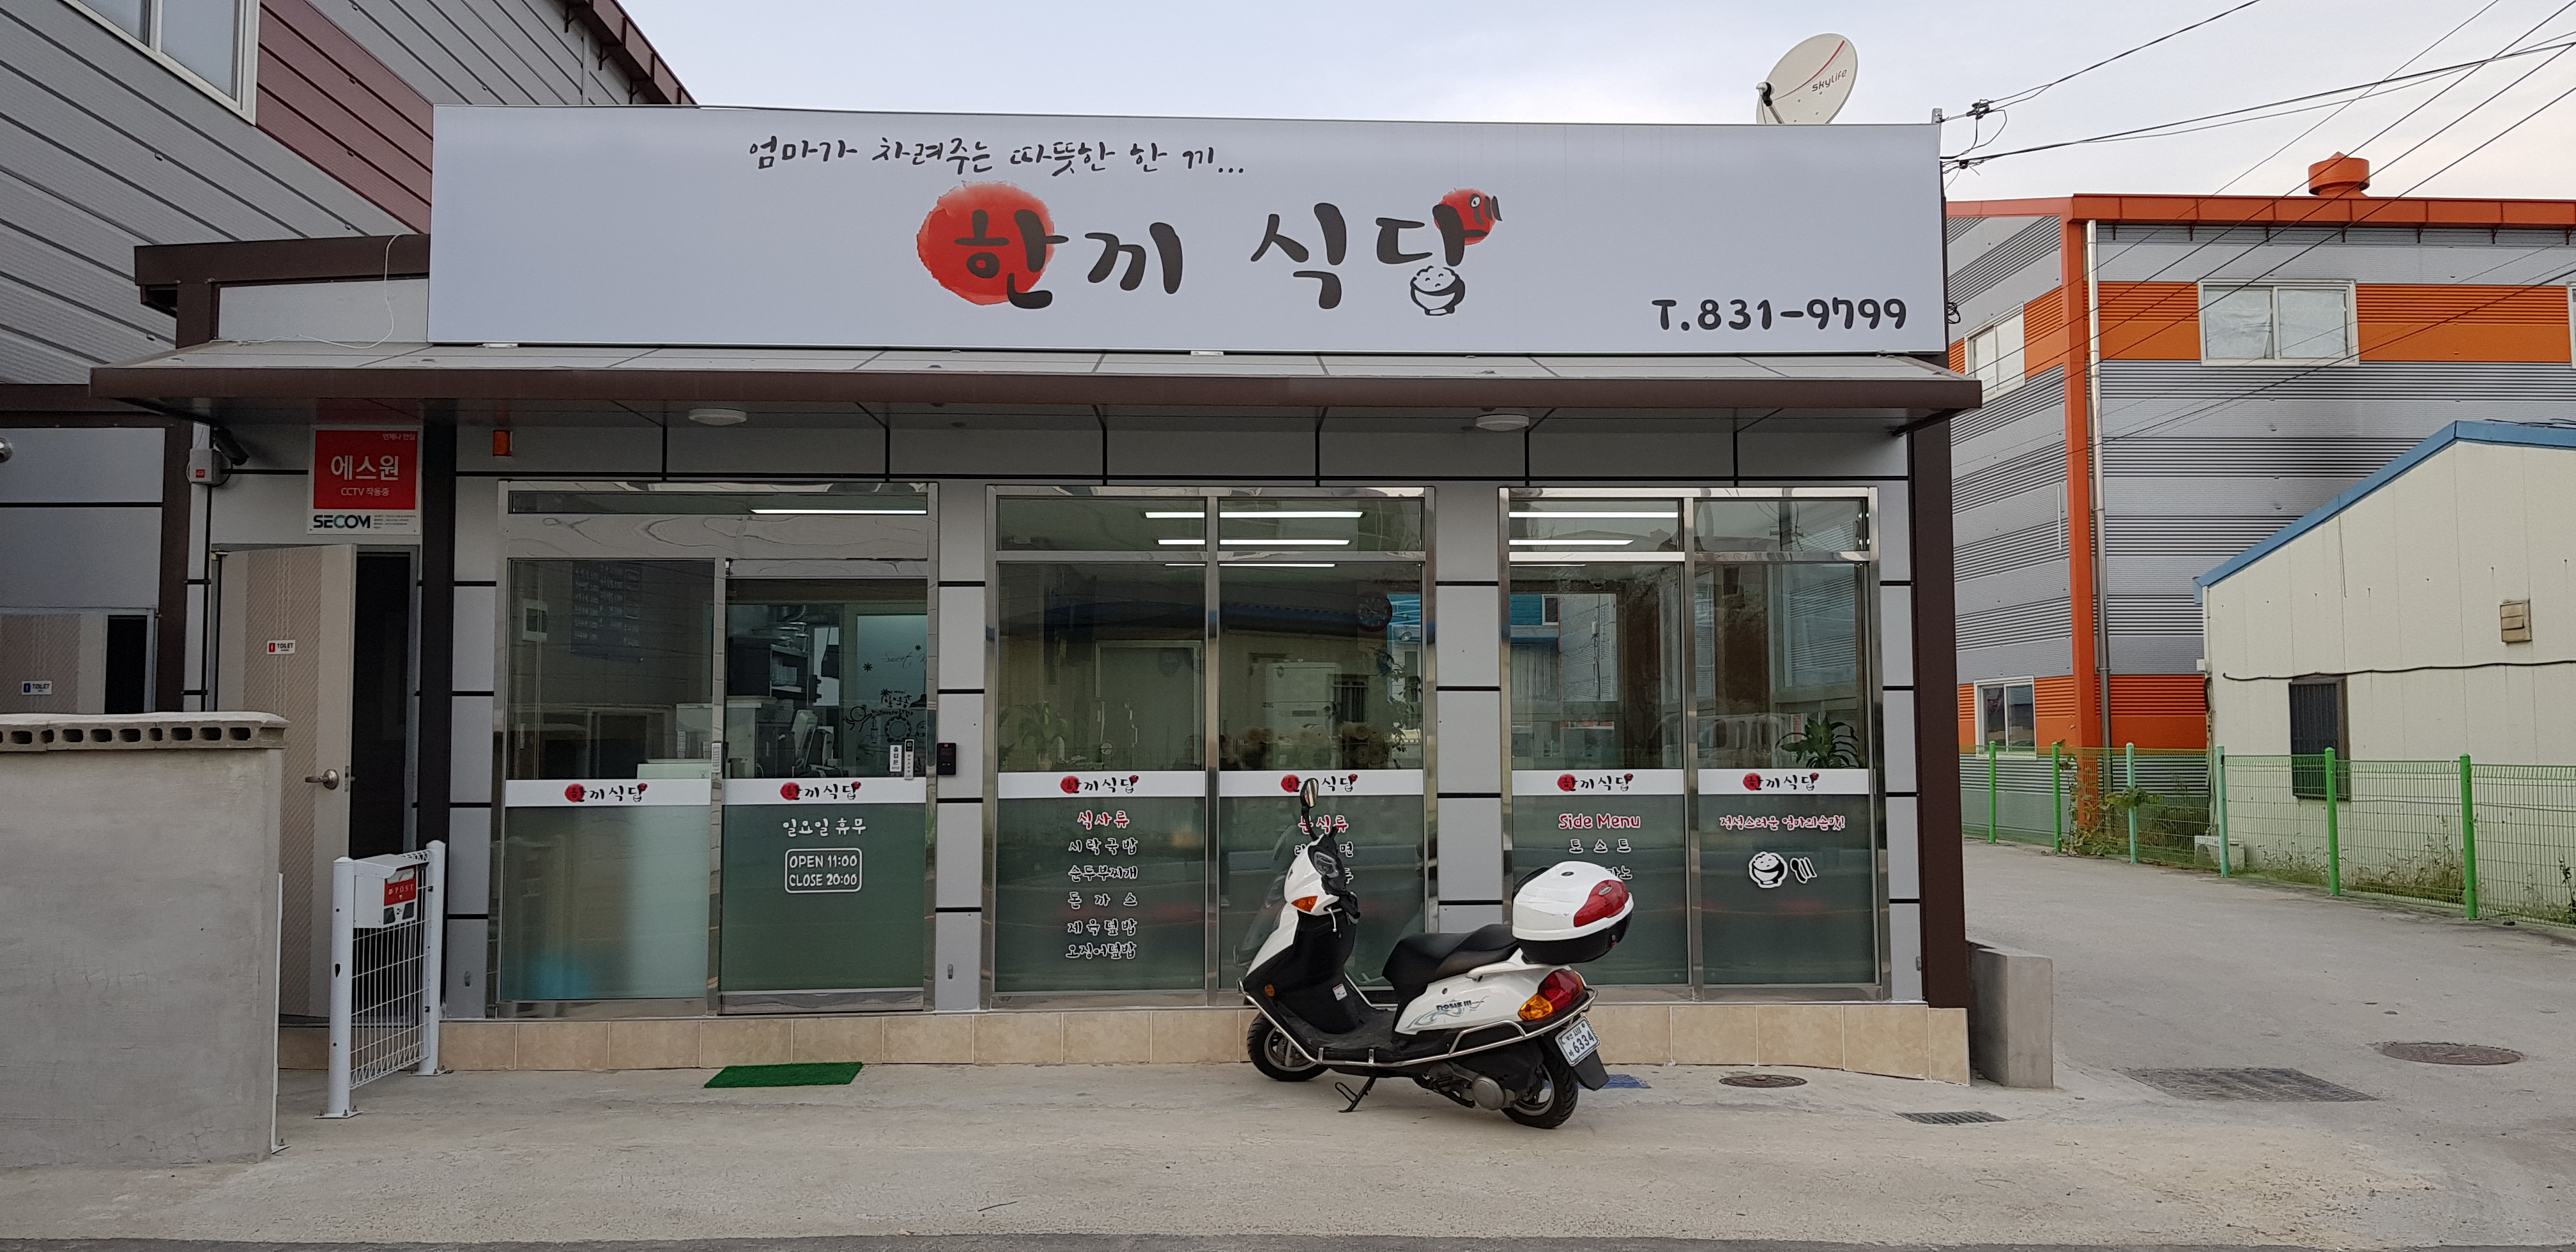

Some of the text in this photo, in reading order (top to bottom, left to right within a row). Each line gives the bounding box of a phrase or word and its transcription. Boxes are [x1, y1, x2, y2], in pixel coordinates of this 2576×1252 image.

[749, 135, 859, 169] 엄마가
[872, 137, 992, 174] 차려주는
[1010, 141, 1116, 176] 따뜻한
[1130, 142, 1168, 172] 한
[954, 208, 1184, 309] 한끼
[1651, 297, 1906, 331] T.831-9799
[330, 455, 400, 481] 에스원
[340, 487, 390, 496] CCTV 작동중
[313, 514, 371, 529] SECOM
[783, 818, 866, 837] 일요일 휴무
[1077, 810, 1130, 830] 식사류
[1558, 813, 1641, 829] Side Menu
[1719, 814, 1779, 830] 정성스러운
[789, 855, 857, 868] OPEN 11:00
[789, 873, 857, 887] CLOSE 20:00
[1068, 865, 1138, 882] 순두부찌개
[394, 883, 415, 894] POST
[1066, 942, 1137, 959] 오징어덮밥
[1572, 1030, 1595, 1053] 6334
